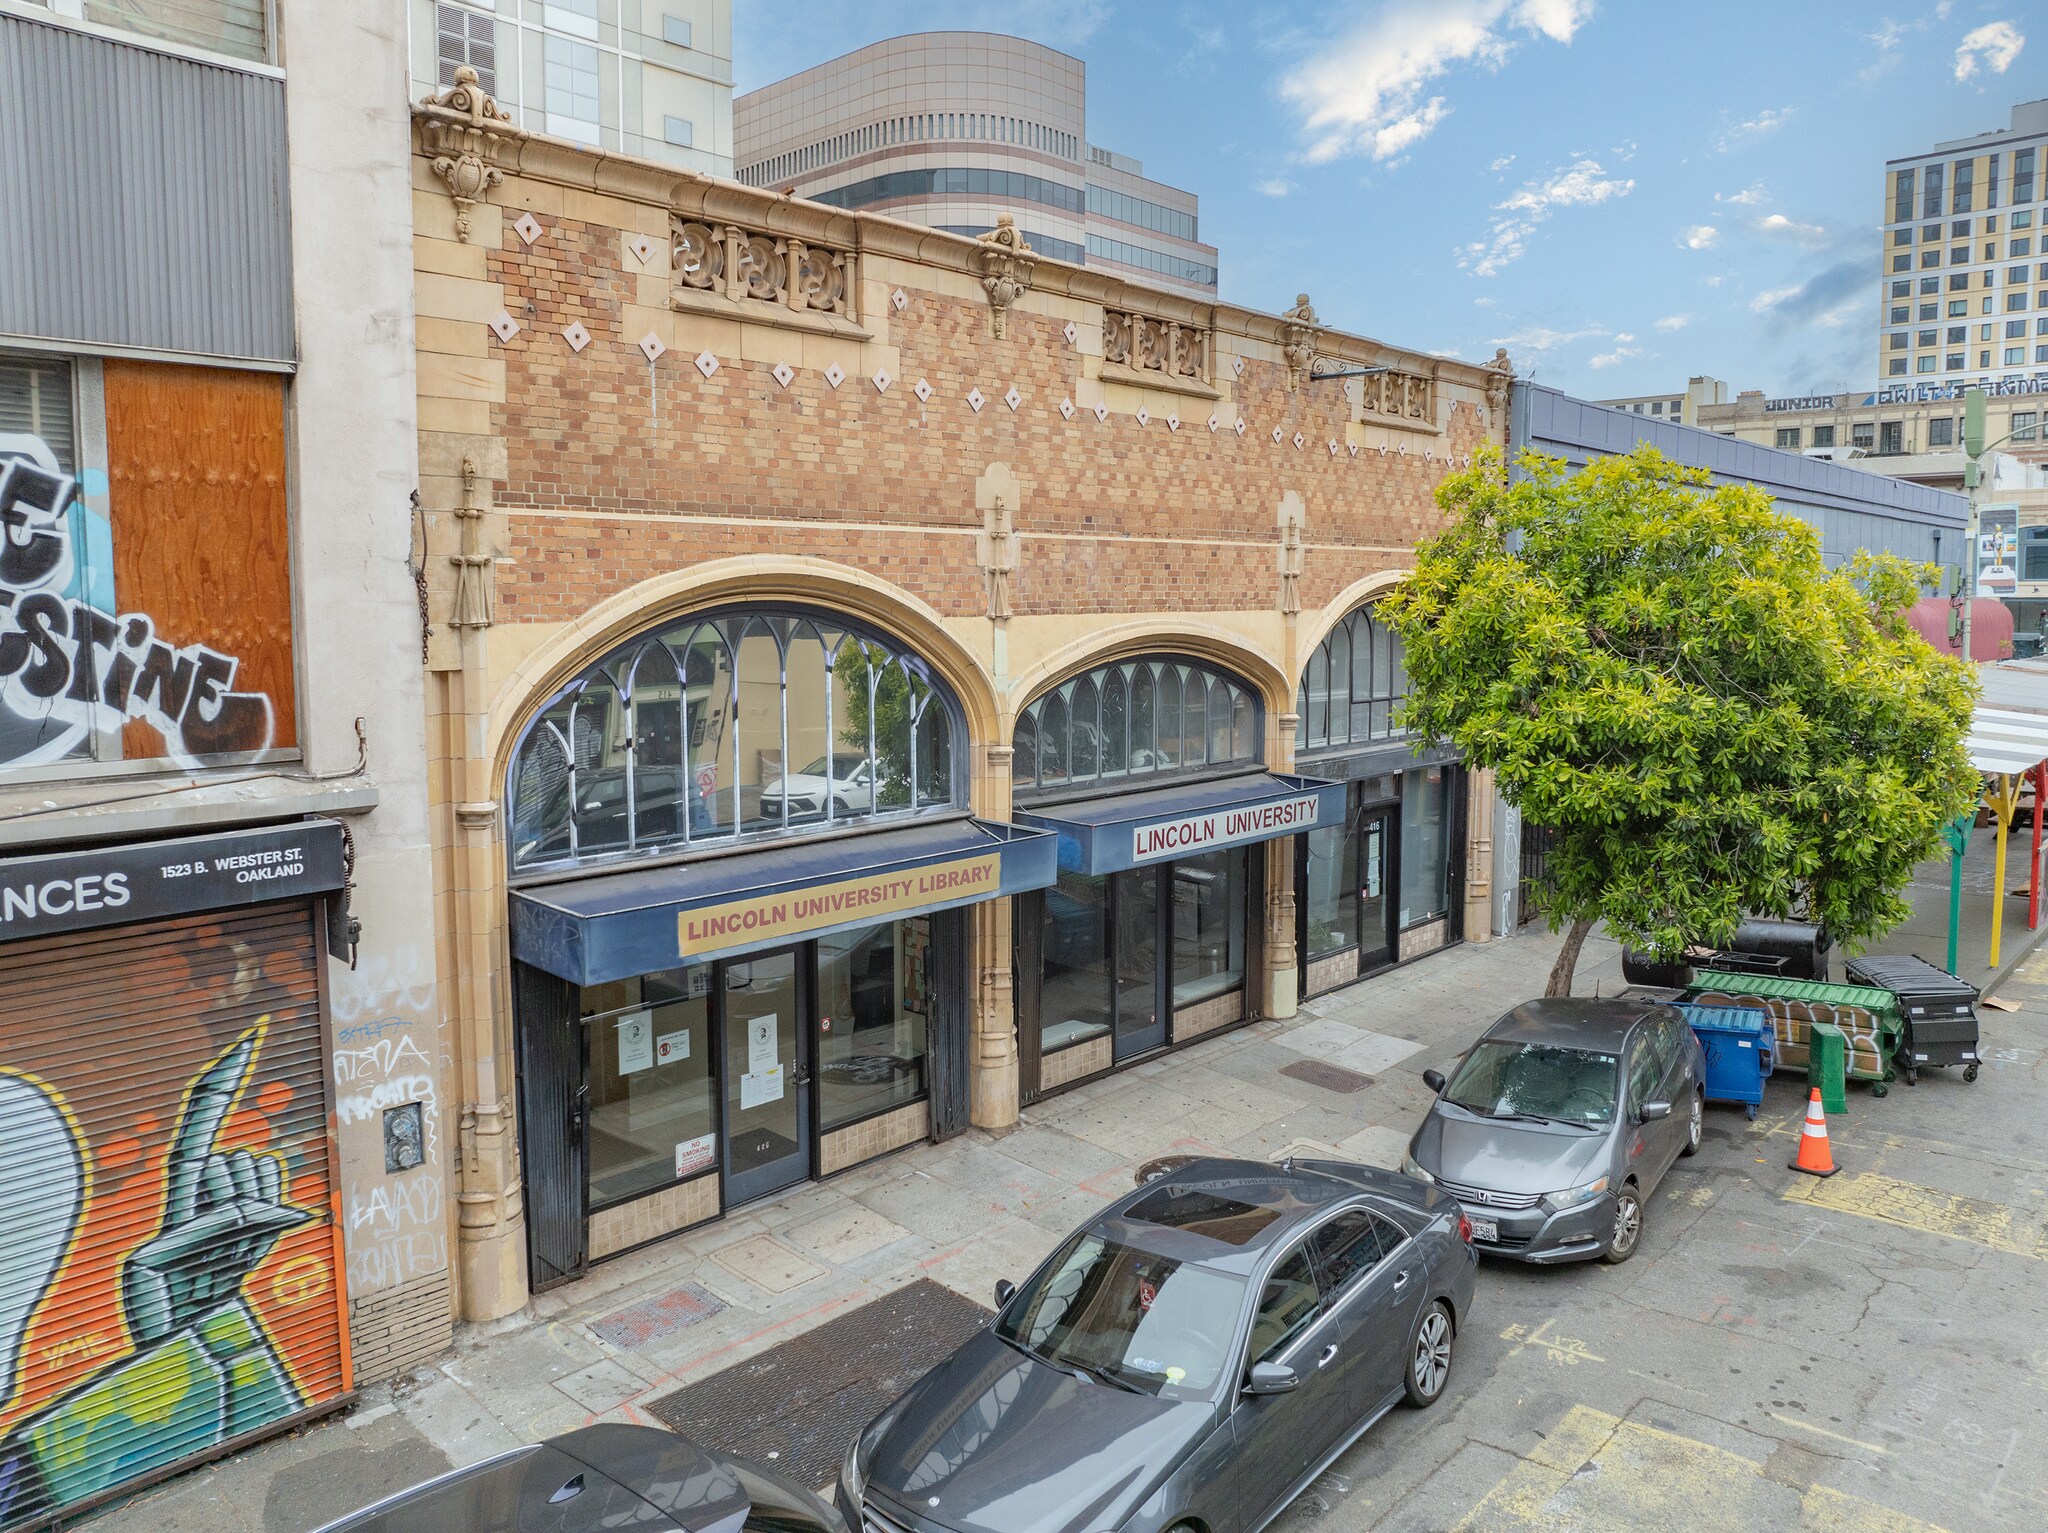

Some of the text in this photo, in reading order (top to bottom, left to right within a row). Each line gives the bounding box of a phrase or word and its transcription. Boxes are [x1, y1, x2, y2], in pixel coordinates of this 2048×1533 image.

[1764, 396, 1837, 412] JUNIOR
[1136, 799, 1318, 855] LINCOLN UNIVERSITY
[1369, 821, 1380, 832] 416
[161, 847, 303, 878] 1523 B. WEBSTER ST.
[236, 863, 304, 883] OAKLAND
[0, 872, 131, 922] NCES
[687, 863, 993, 941] LINCOLN UNIVERSITY LIBRARY
[681, 1144, 711, 1159] SMOKING
[691, 1140, 701, 1149] NO
